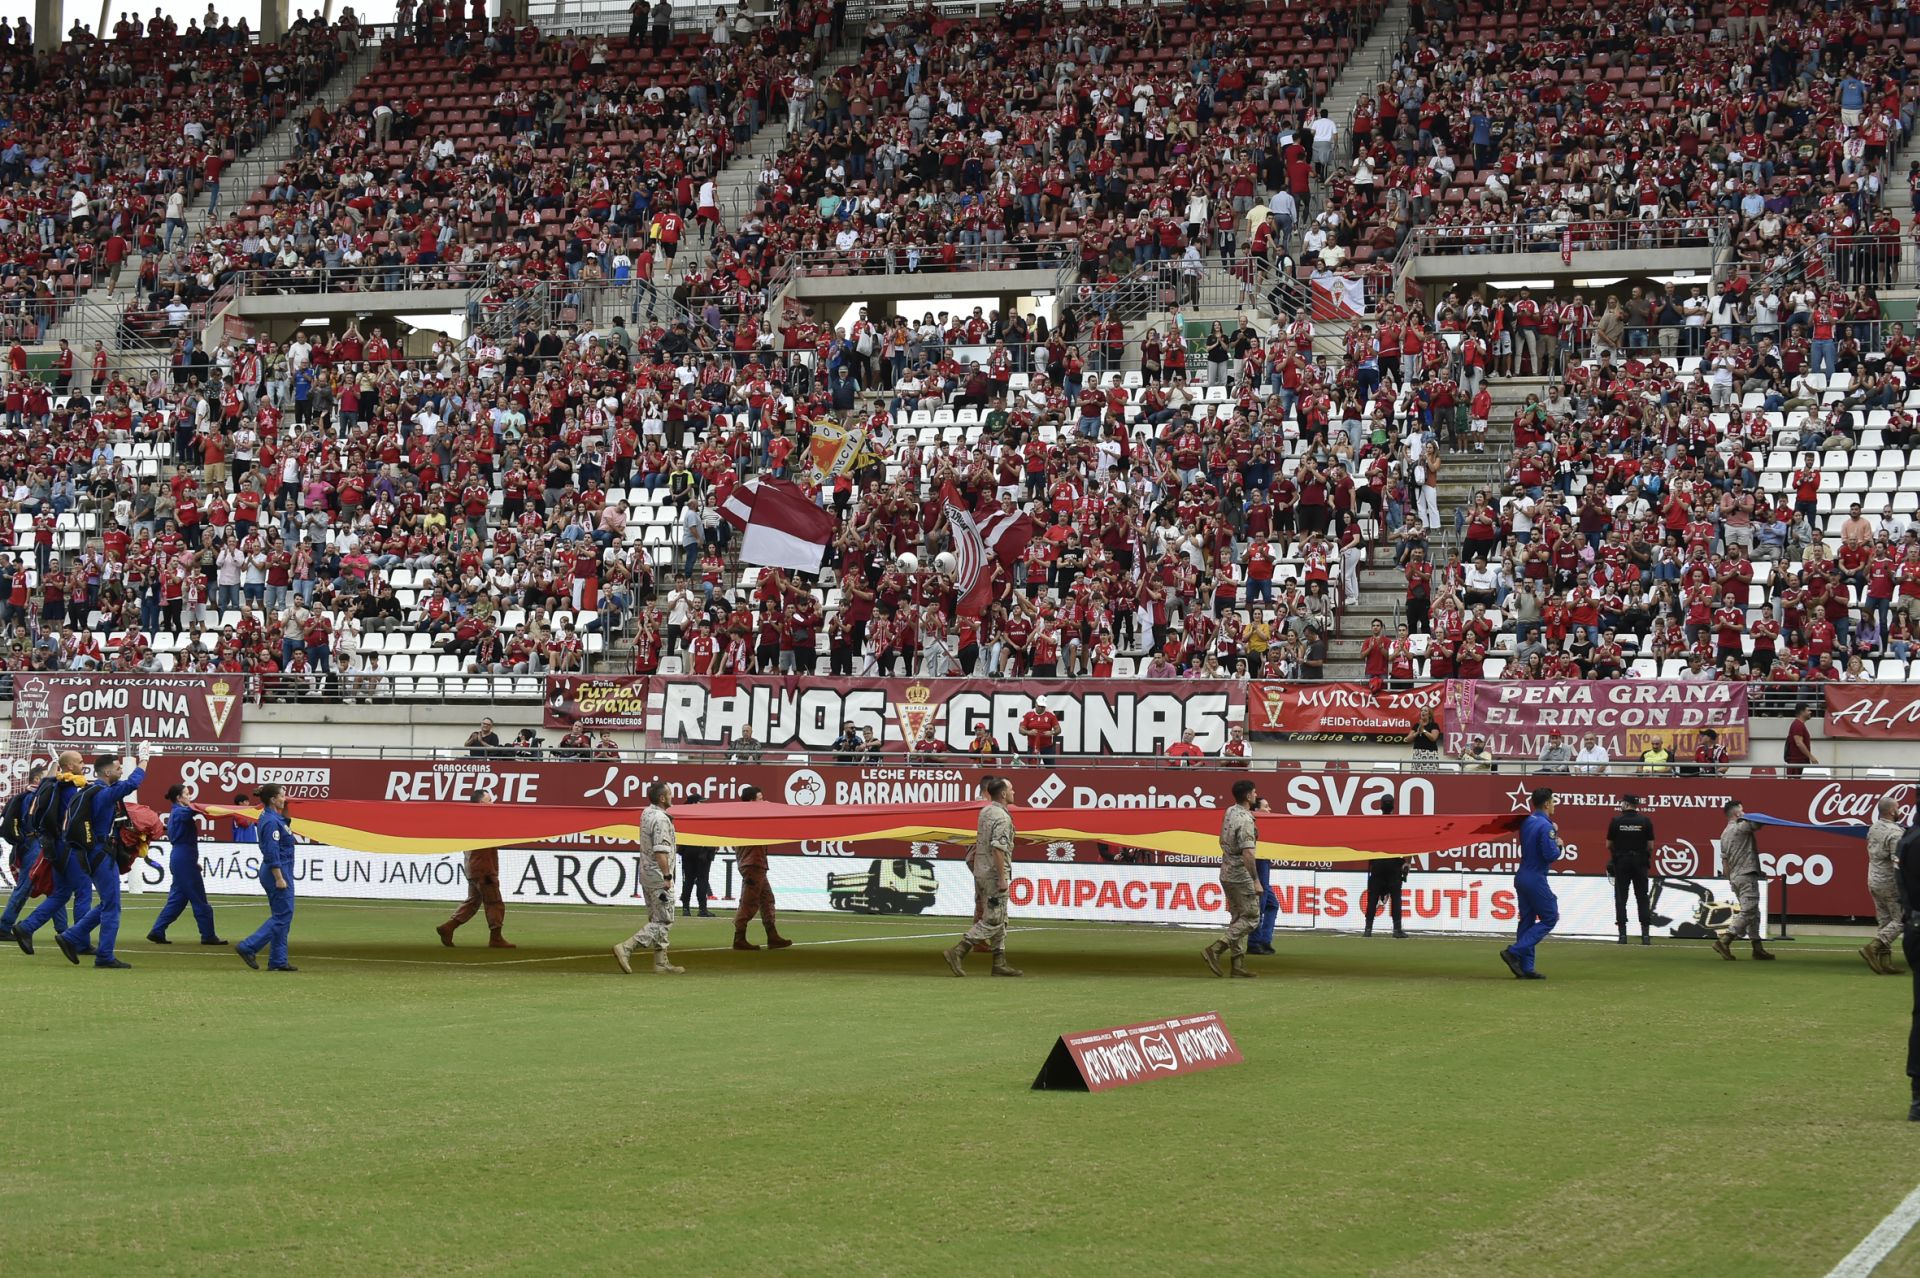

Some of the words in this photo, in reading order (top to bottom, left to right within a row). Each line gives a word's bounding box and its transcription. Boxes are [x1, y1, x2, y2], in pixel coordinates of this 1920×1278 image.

[666, 219, 675, 230] 21
[49, 677, 91, 686] PEÑA
[100, 678, 207, 688] MURCIANISTA
[593, 680, 614, 688] Peña
[1388, 689, 1440, 709] 2008
[1499, 681, 1594, 704] PEÑA
[1608, 684, 1732, 704] GRANA
[63, 688, 129, 714] COMO
[142, 688, 190, 717] UNA
[595, 717, 642, 726] PACHEQUEROS
[944, 691, 1229, 755] GRANAS
[1485, 707, 1524, 725] EL
[1536, 708, 1670, 727] RINCON
[1680, 707, 1745, 726] DEL
[61, 716, 117, 737] SOLA
[130, 716, 190, 739] ALMA
[1288, 732, 1344, 742] Fundada
[262, 770, 326, 782] SPORTS
[432, 764, 491, 773] CARROCERIAS
[861, 769, 905, 780] LECHE
[909, 769, 963, 781] FRESCA
[384, 771, 540, 803] REVERTE
[1073, 785, 1216, 808] Domino's
[1648, 794, 1733, 809] LEVANTE
[203, 850, 259, 879] MÁS
[334, 859, 371, 883] UN
